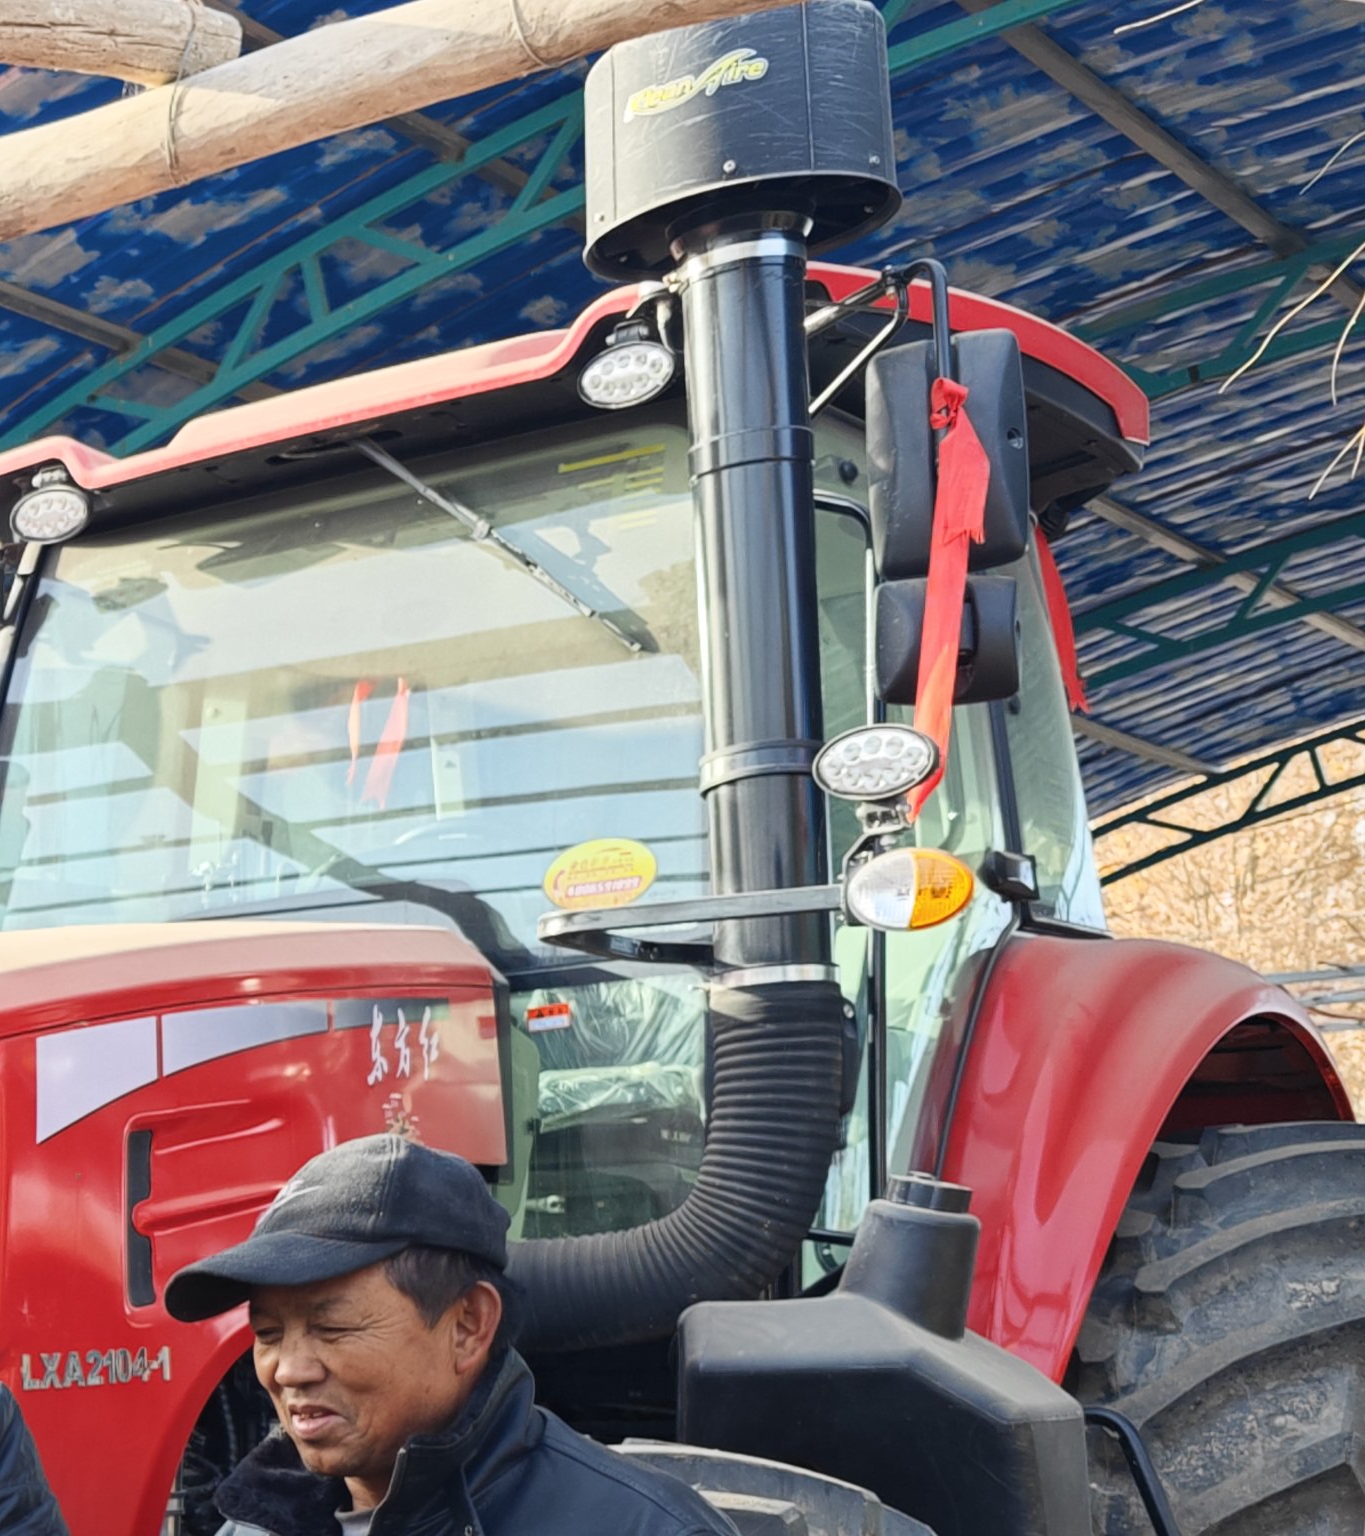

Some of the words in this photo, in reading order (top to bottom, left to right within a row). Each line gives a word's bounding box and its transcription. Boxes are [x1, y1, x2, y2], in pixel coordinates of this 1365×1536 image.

[367, 1003, 440, 1086] 东方红
[21, 1345, 172, 1391] LXA2104-1
